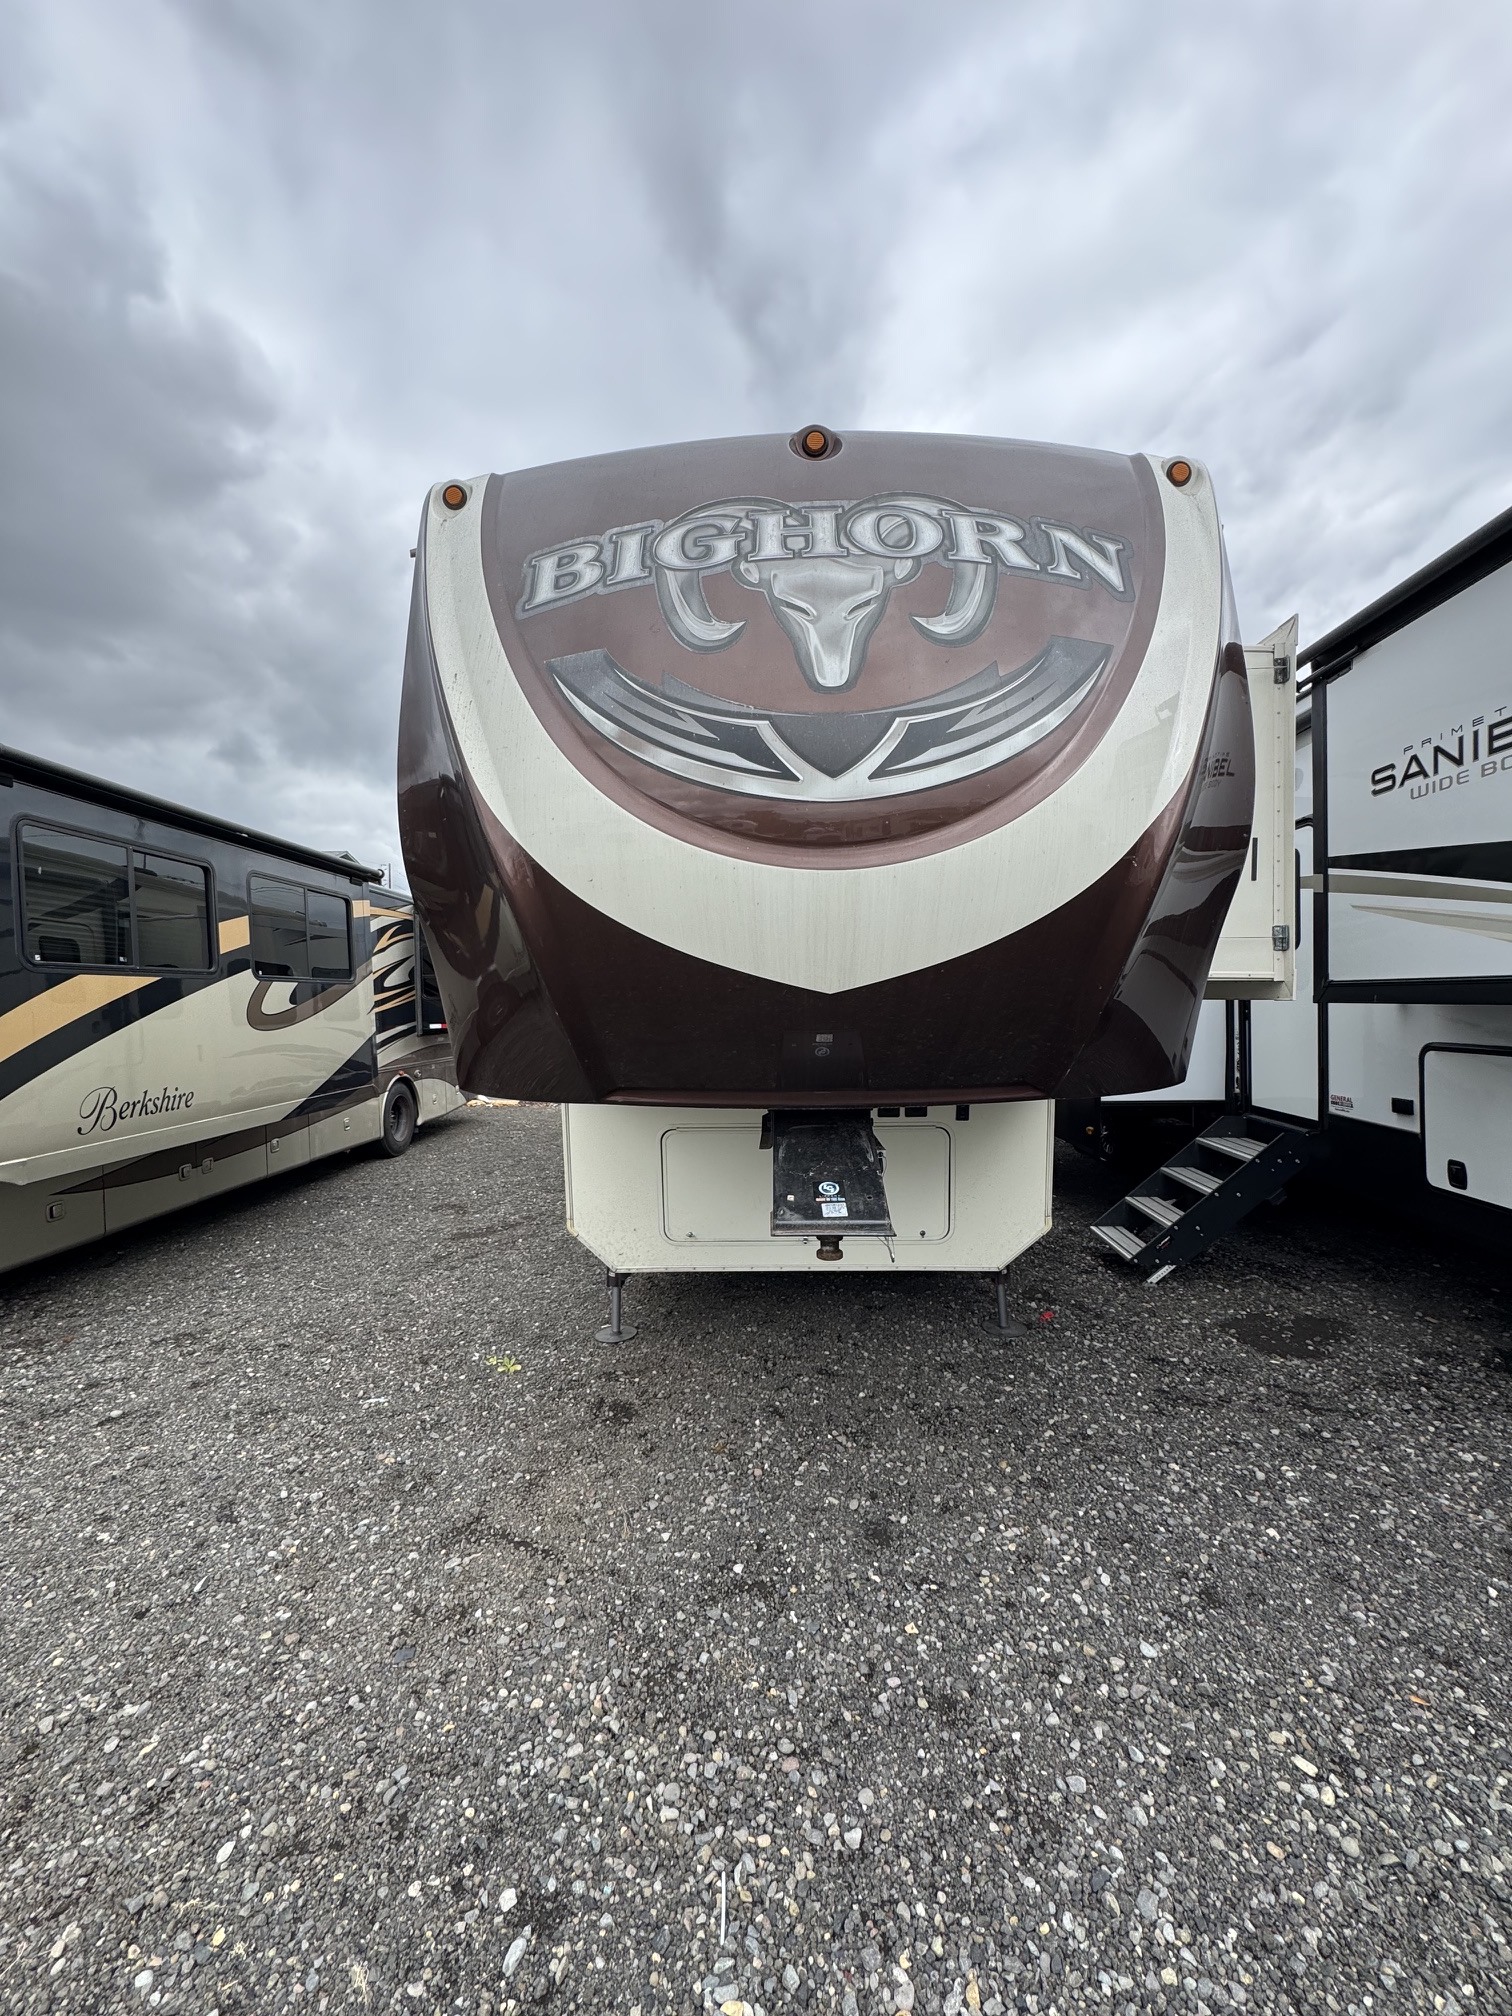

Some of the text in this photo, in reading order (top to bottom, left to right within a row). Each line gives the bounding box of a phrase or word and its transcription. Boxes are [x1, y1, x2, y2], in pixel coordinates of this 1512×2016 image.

[520, 502, 1129, 612] BIGHORN
[1410, 769, 1470, 800] WIDE
[77, 1086, 195, 1136] Berkshire
[1330, 1094, 1354, 1104] GENERAL
